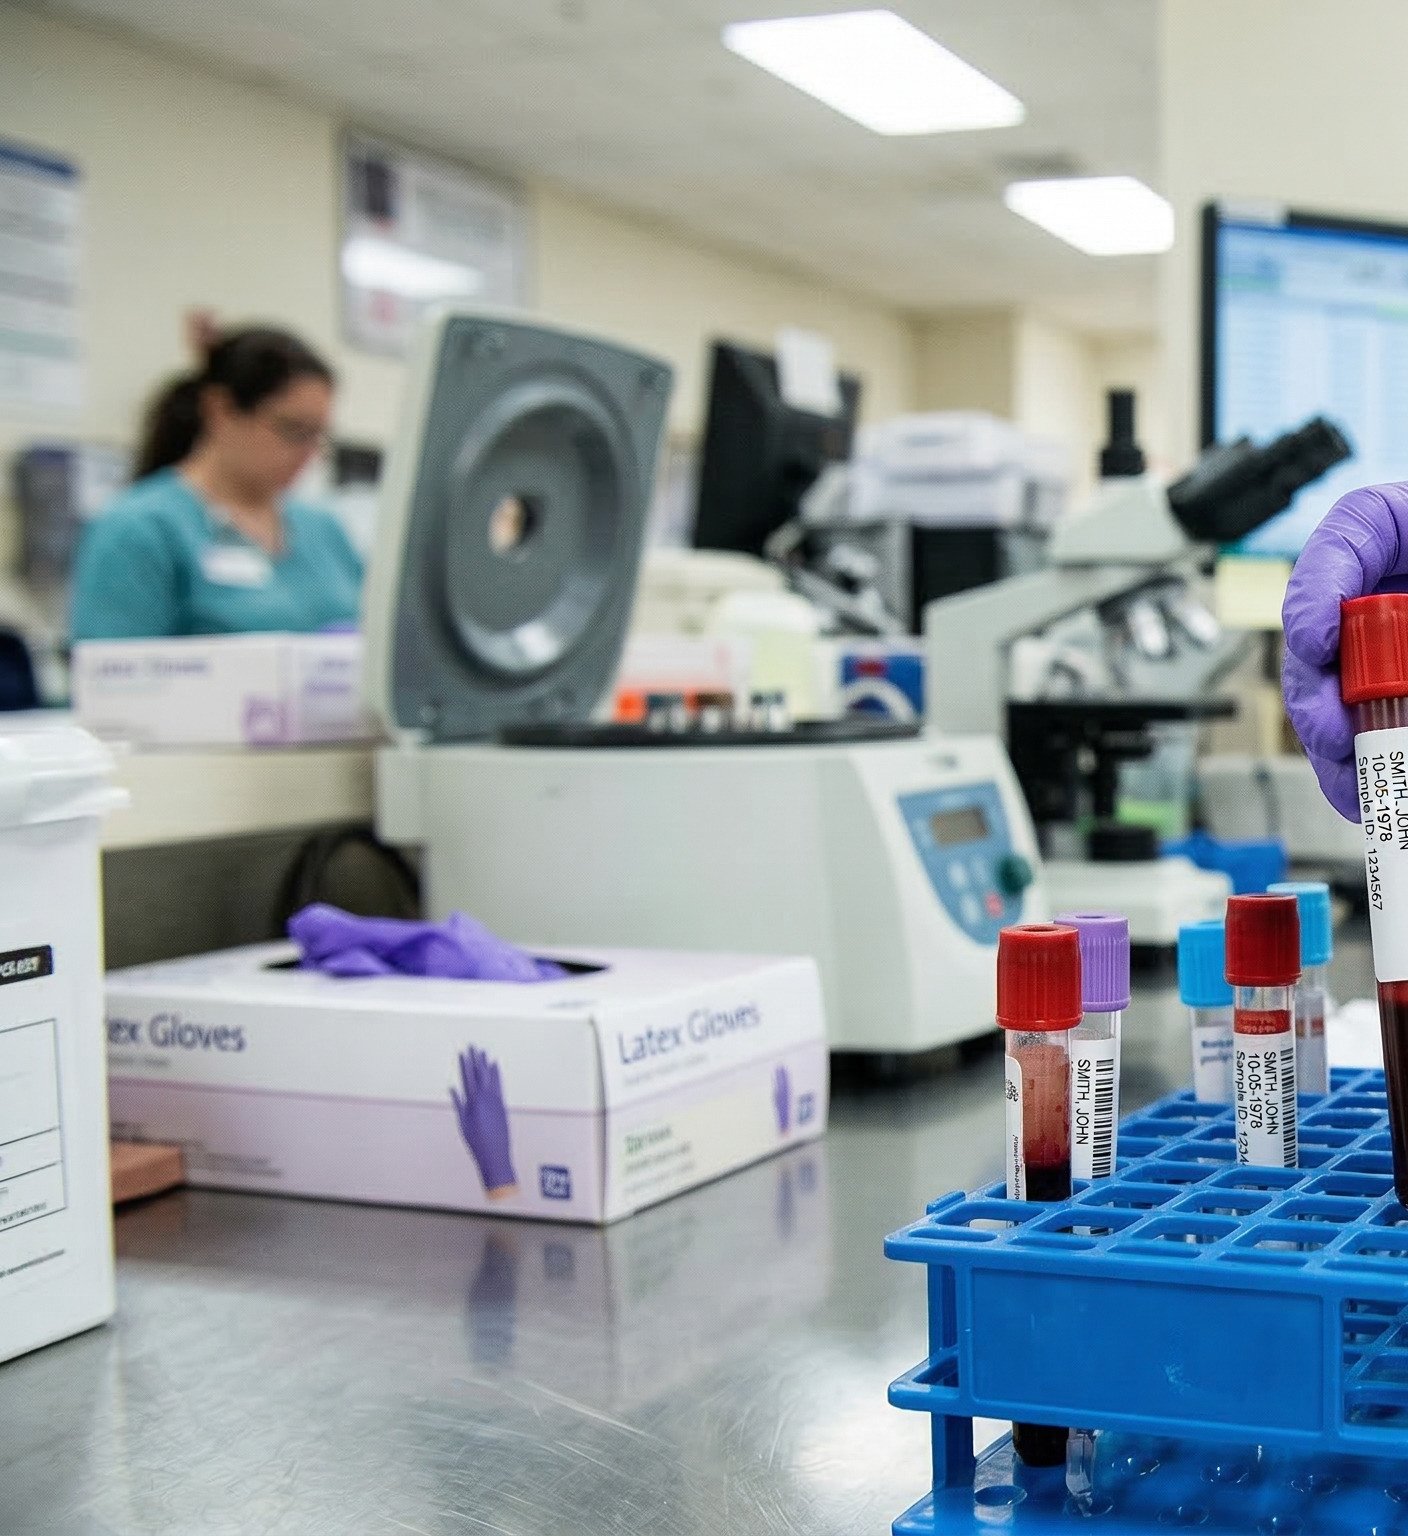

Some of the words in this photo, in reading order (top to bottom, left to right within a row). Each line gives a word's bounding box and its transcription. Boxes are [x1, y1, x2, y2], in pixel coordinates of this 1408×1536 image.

[1358, 756, 1374, 814] Sample
[1372, 753, 1393, 842] 10-05-1978
[1364, 819, 1375, 841] ID:
[106, 1016, 142, 1045] ex
[149, 1011, 247, 1052] Gloves
[617, 1022, 683, 1065] Latex
[1247, 1052, 1263, 1129] 10-05-1978
[1075, 1107, 1090, 1145] JOHN
[1265, 1098, 1280, 1135] JOHN
